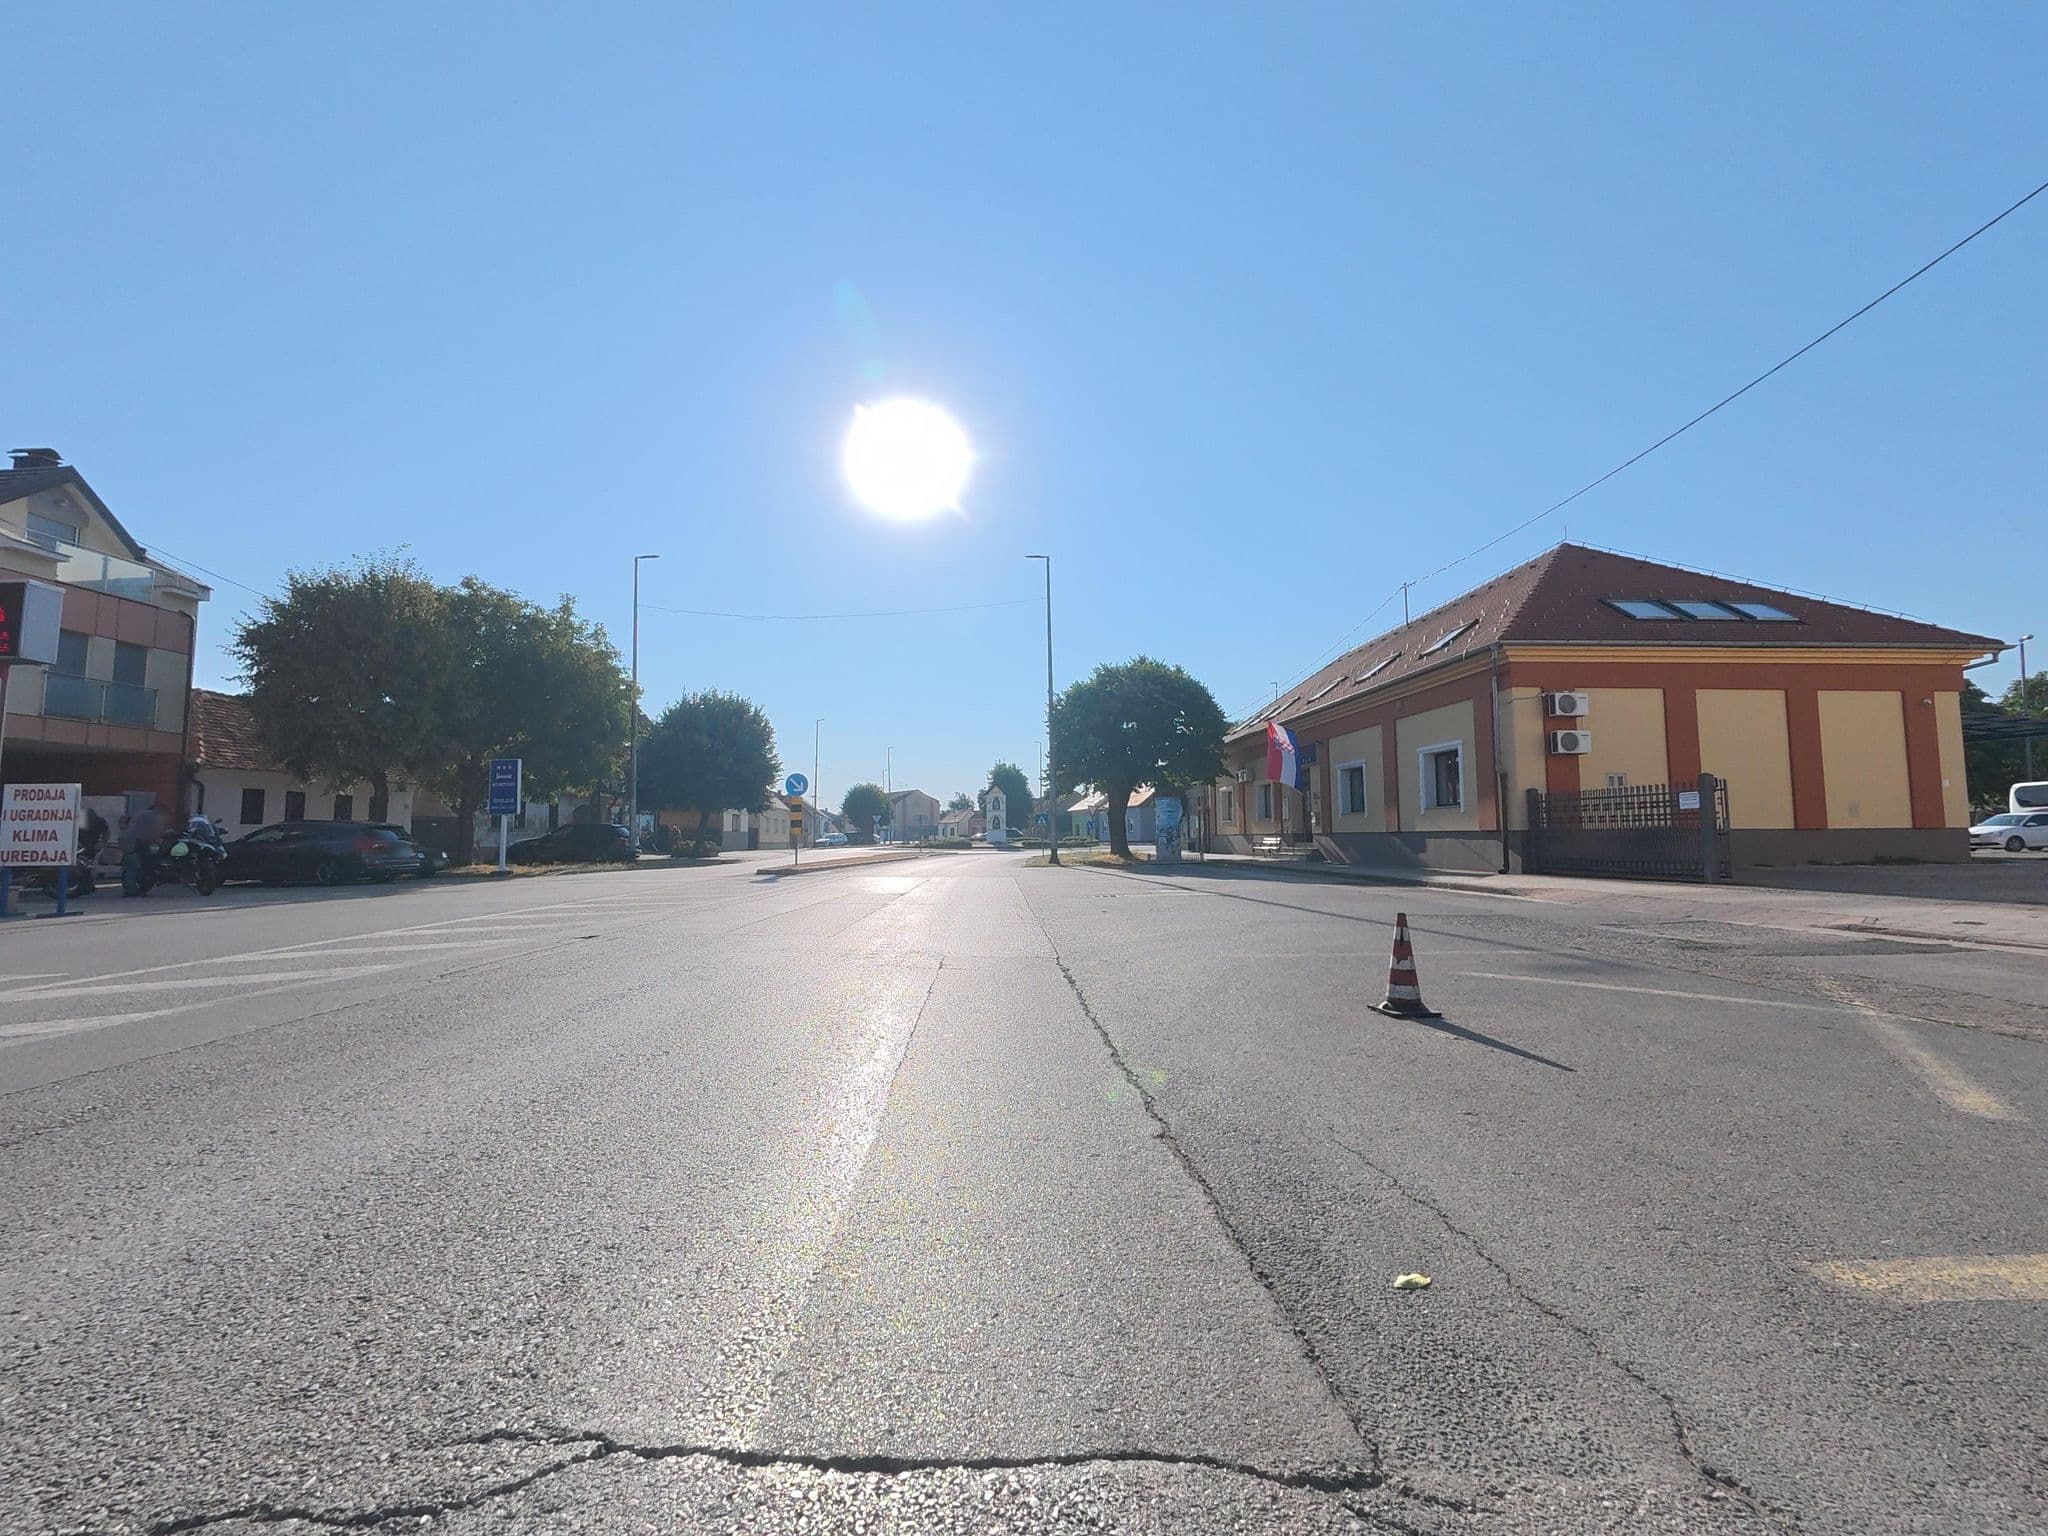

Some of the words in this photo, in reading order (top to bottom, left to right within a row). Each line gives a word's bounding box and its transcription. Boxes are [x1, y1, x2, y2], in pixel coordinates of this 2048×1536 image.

[13, 788, 65, 801] PRODAJA
[10, 809, 72, 821] UGRADNJA
[12, 830, 58, 842] KLIMA
